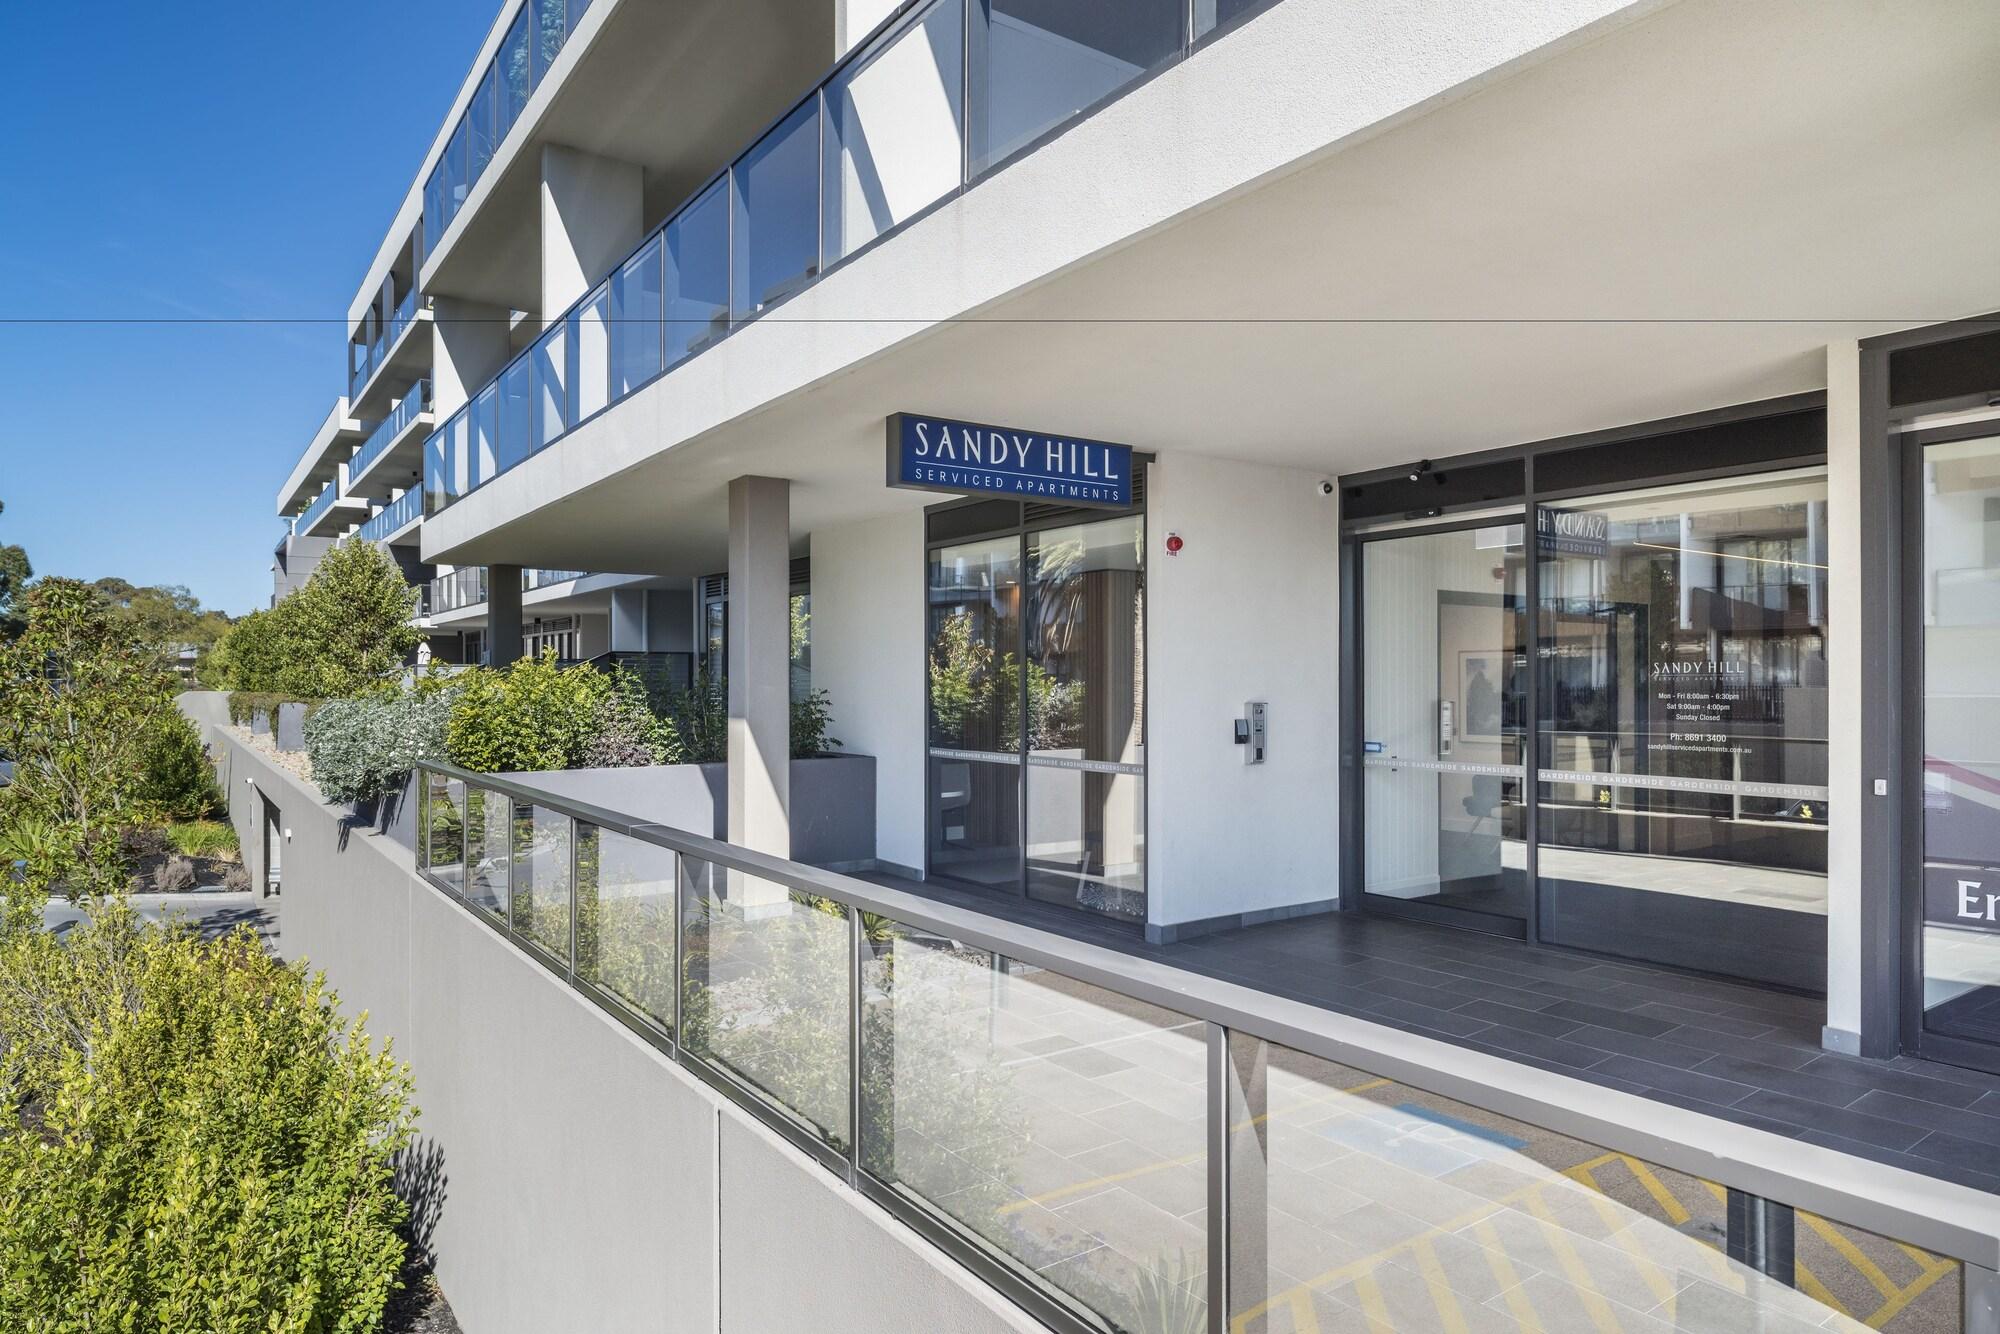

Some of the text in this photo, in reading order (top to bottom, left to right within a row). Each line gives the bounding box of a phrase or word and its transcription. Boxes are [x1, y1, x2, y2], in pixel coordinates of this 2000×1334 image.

[915, 422, 1119, 480] SANDY HILL
[915, 468, 1119, 501] SERVICED APARTMENTS
[1653, 661, 1744, 673] SANDY HILL
[1715, 693, 1739, 701] 6:30pm
[1675, 713, 1698, 721] Sunday
[1670, 732, 1682, 741] Ph:
[1706, 734, 1727, 742] 3400
[1540, 772, 1818, 797] GARDENSIDE GARDENSIDE GARDENSIDE GARDENSIDE
